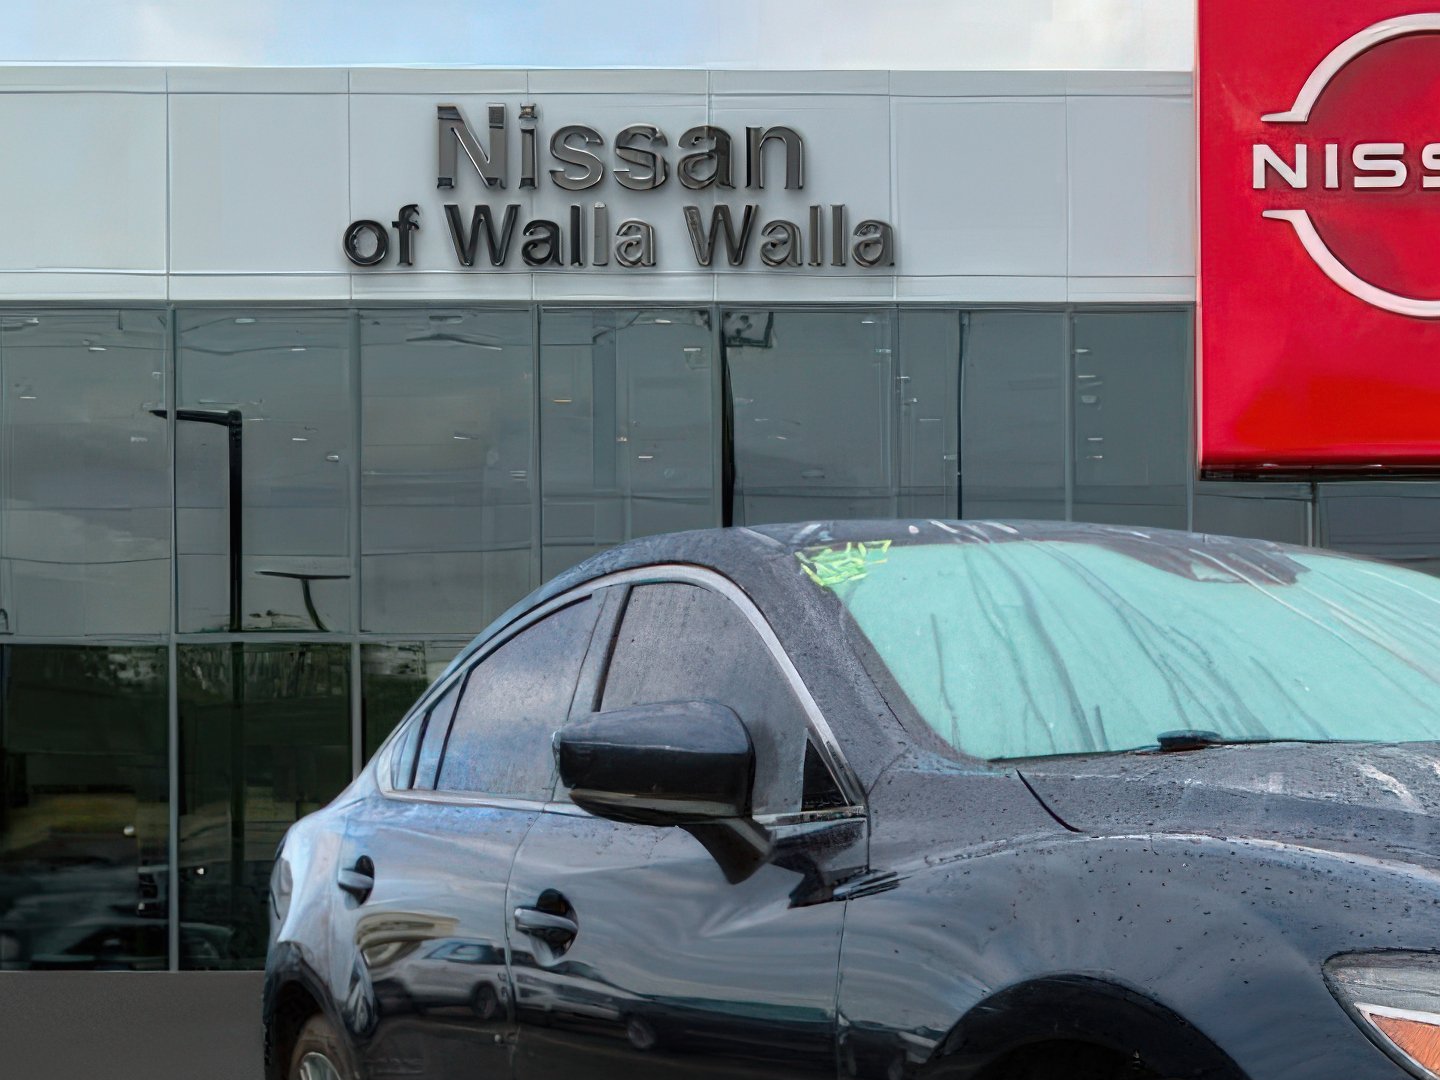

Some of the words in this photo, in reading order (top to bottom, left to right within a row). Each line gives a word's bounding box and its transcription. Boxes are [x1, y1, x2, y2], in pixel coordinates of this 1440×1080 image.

[436, 102, 805, 191] Nissan
[342, 203, 421, 267] of
[443, 201, 657, 268] Walla
[682, 202, 896, 268] Walla
